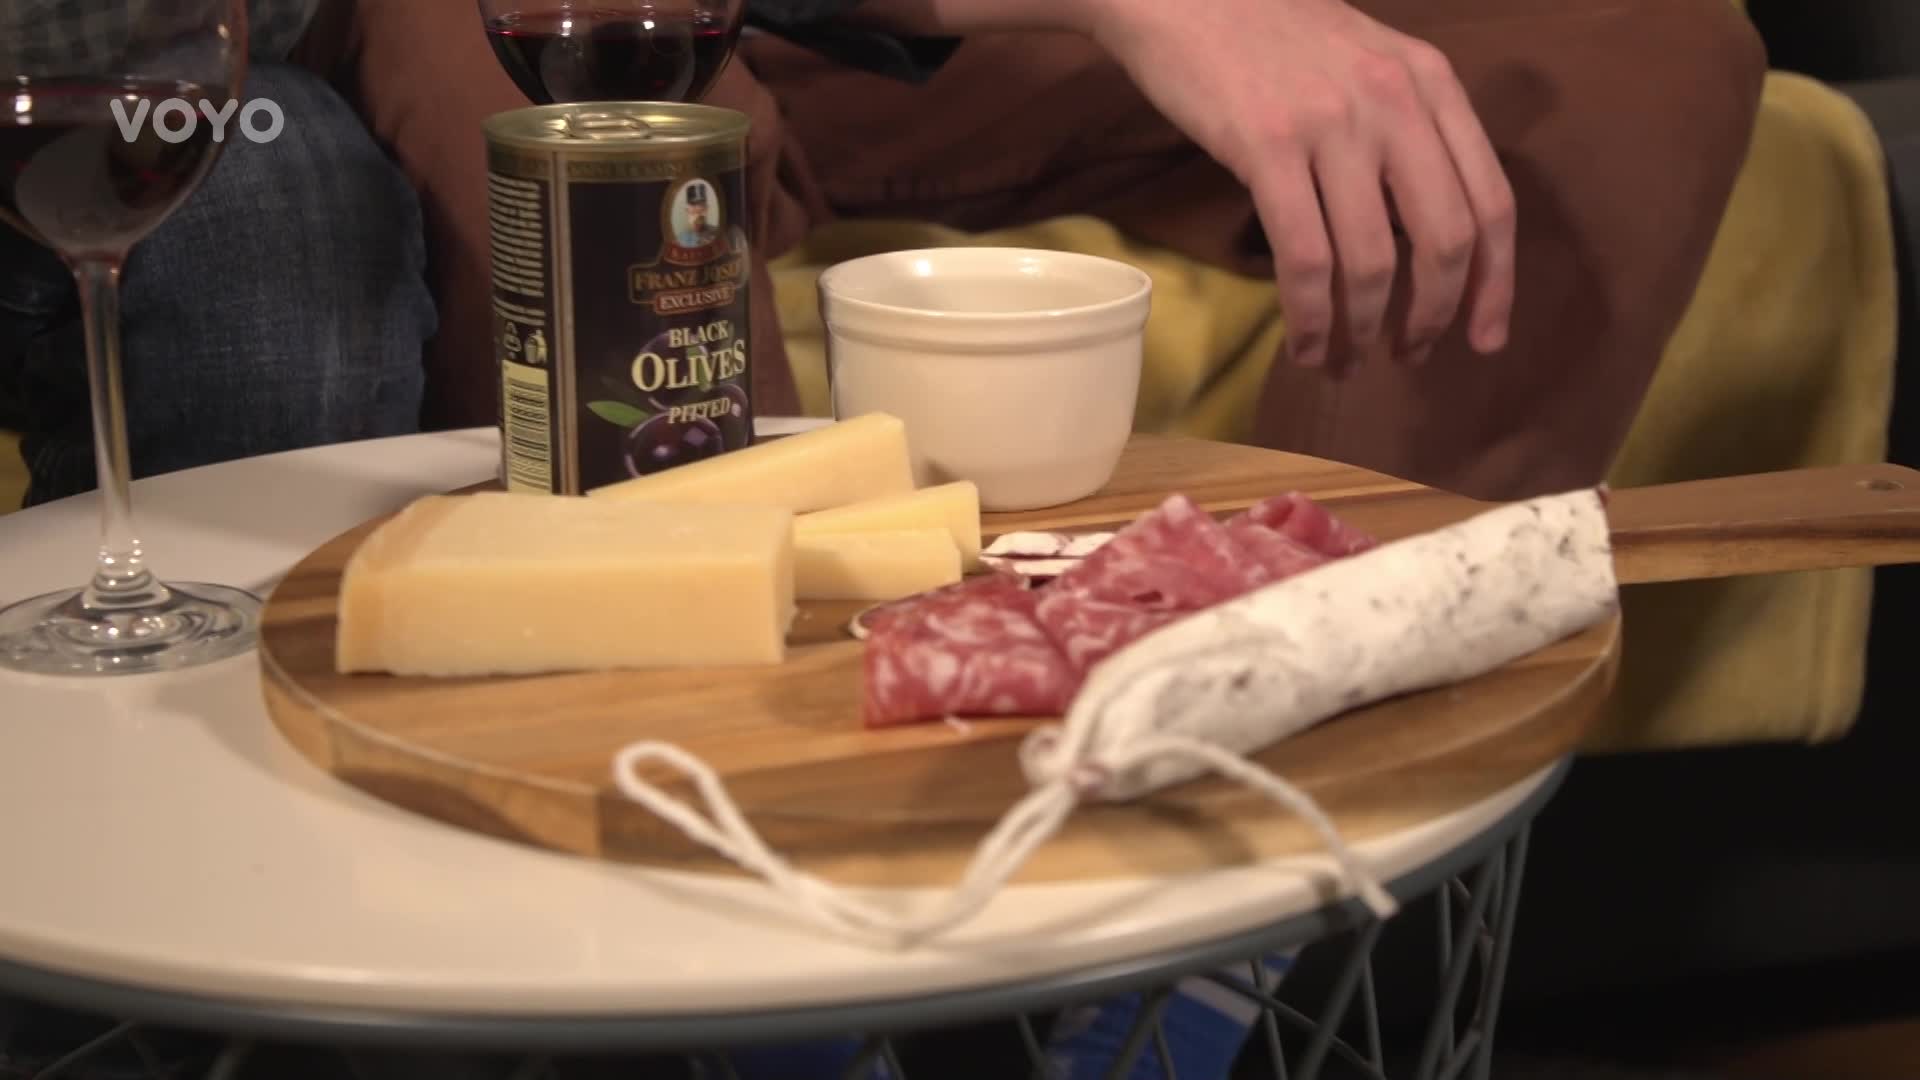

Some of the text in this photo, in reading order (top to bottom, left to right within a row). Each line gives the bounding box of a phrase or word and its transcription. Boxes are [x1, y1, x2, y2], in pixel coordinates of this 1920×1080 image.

[635, 269, 696, 289] FRANZ
[660, 286, 731, 310] EXCLUSIVE
[669, 320, 730, 348] BLACK
[631, 339, 745, 393] OLIVES
[667, 398, 731, 424] PITTED
